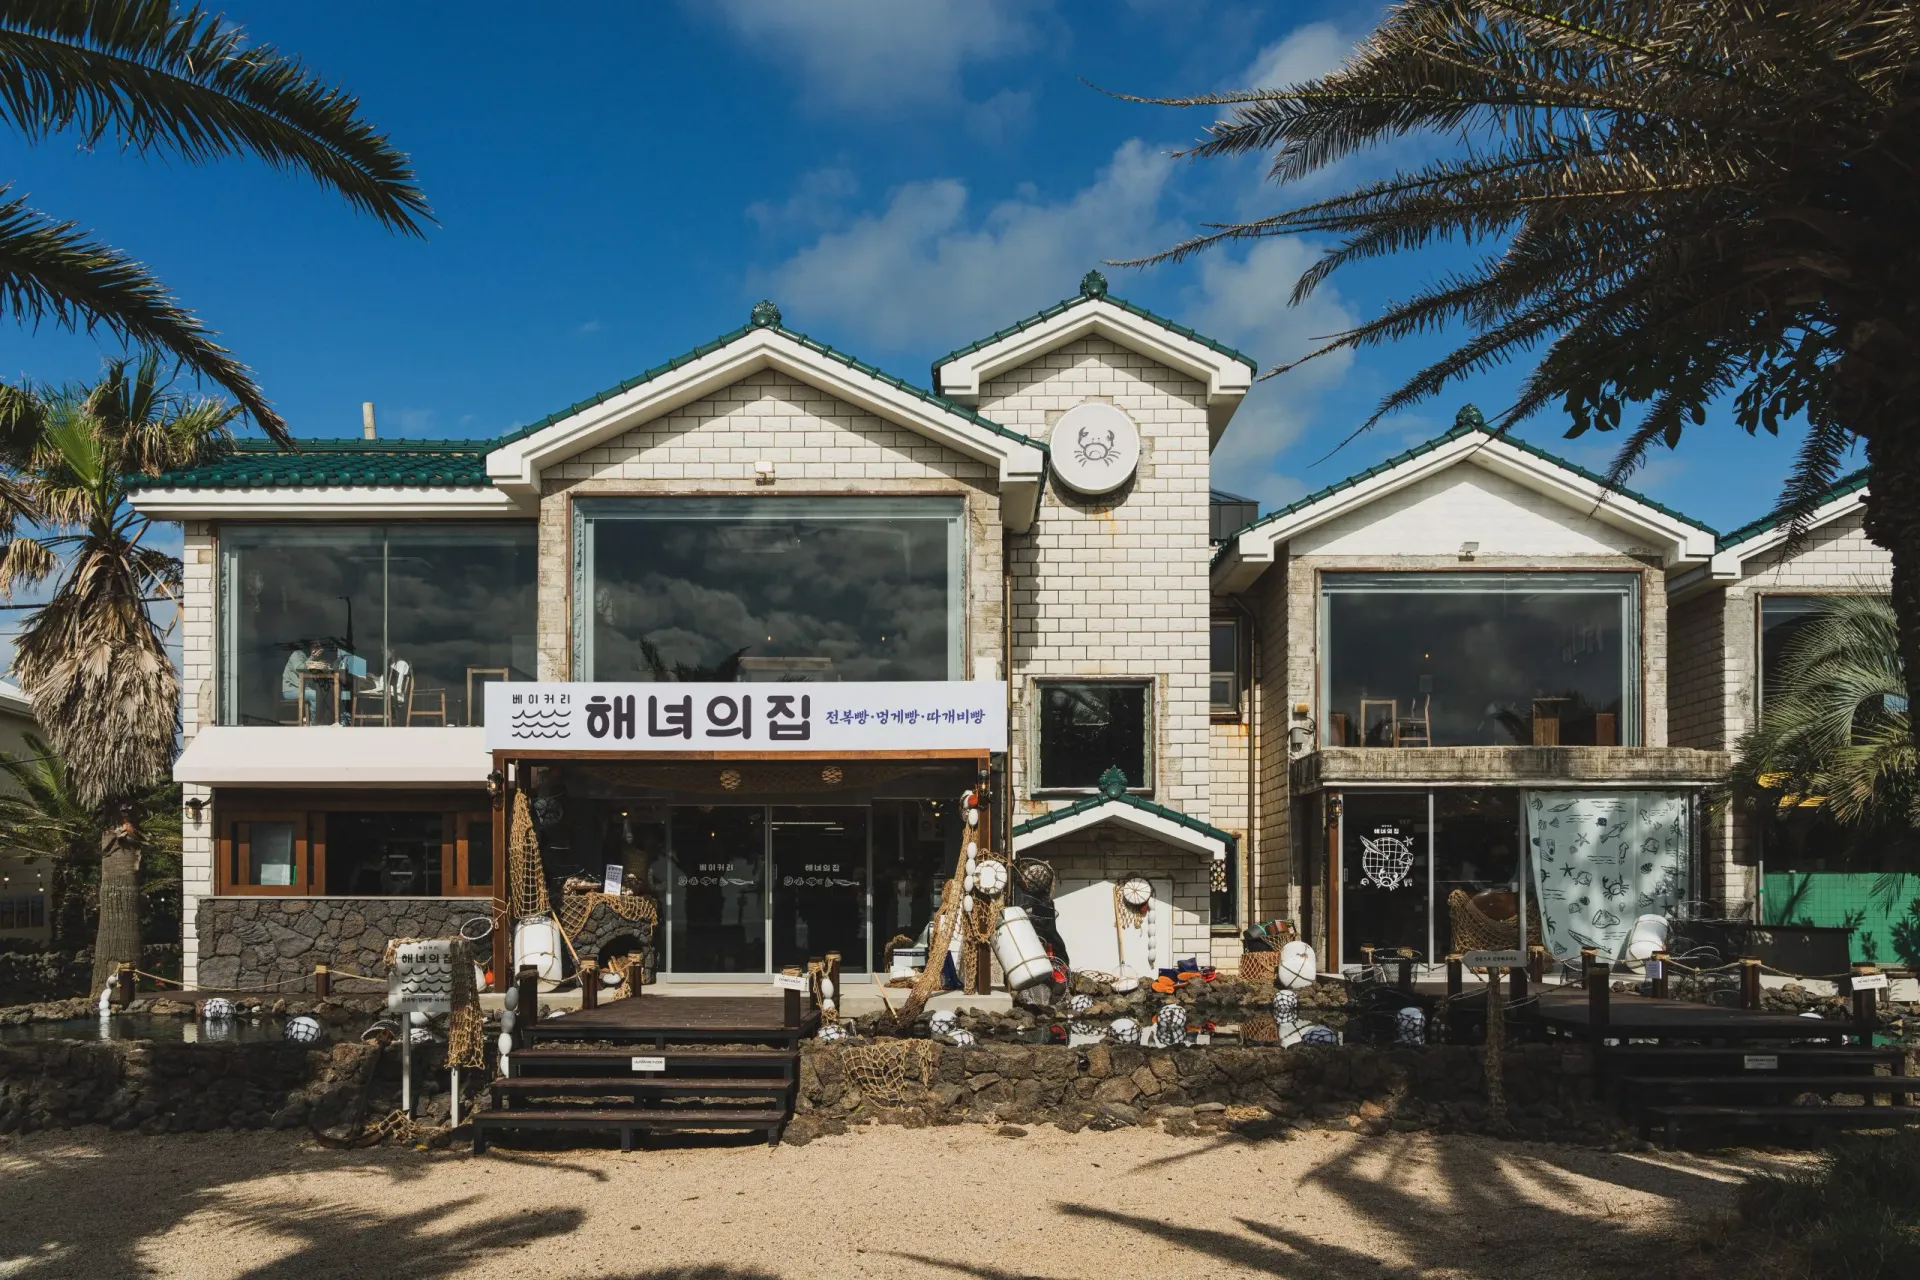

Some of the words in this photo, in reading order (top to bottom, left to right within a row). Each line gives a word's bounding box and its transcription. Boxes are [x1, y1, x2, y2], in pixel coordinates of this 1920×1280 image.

[512, 693, 571, 705] 베이커리
[584, 694, 811, 741] 해녀의집
[699, 863, 734, 872] 베이커리
